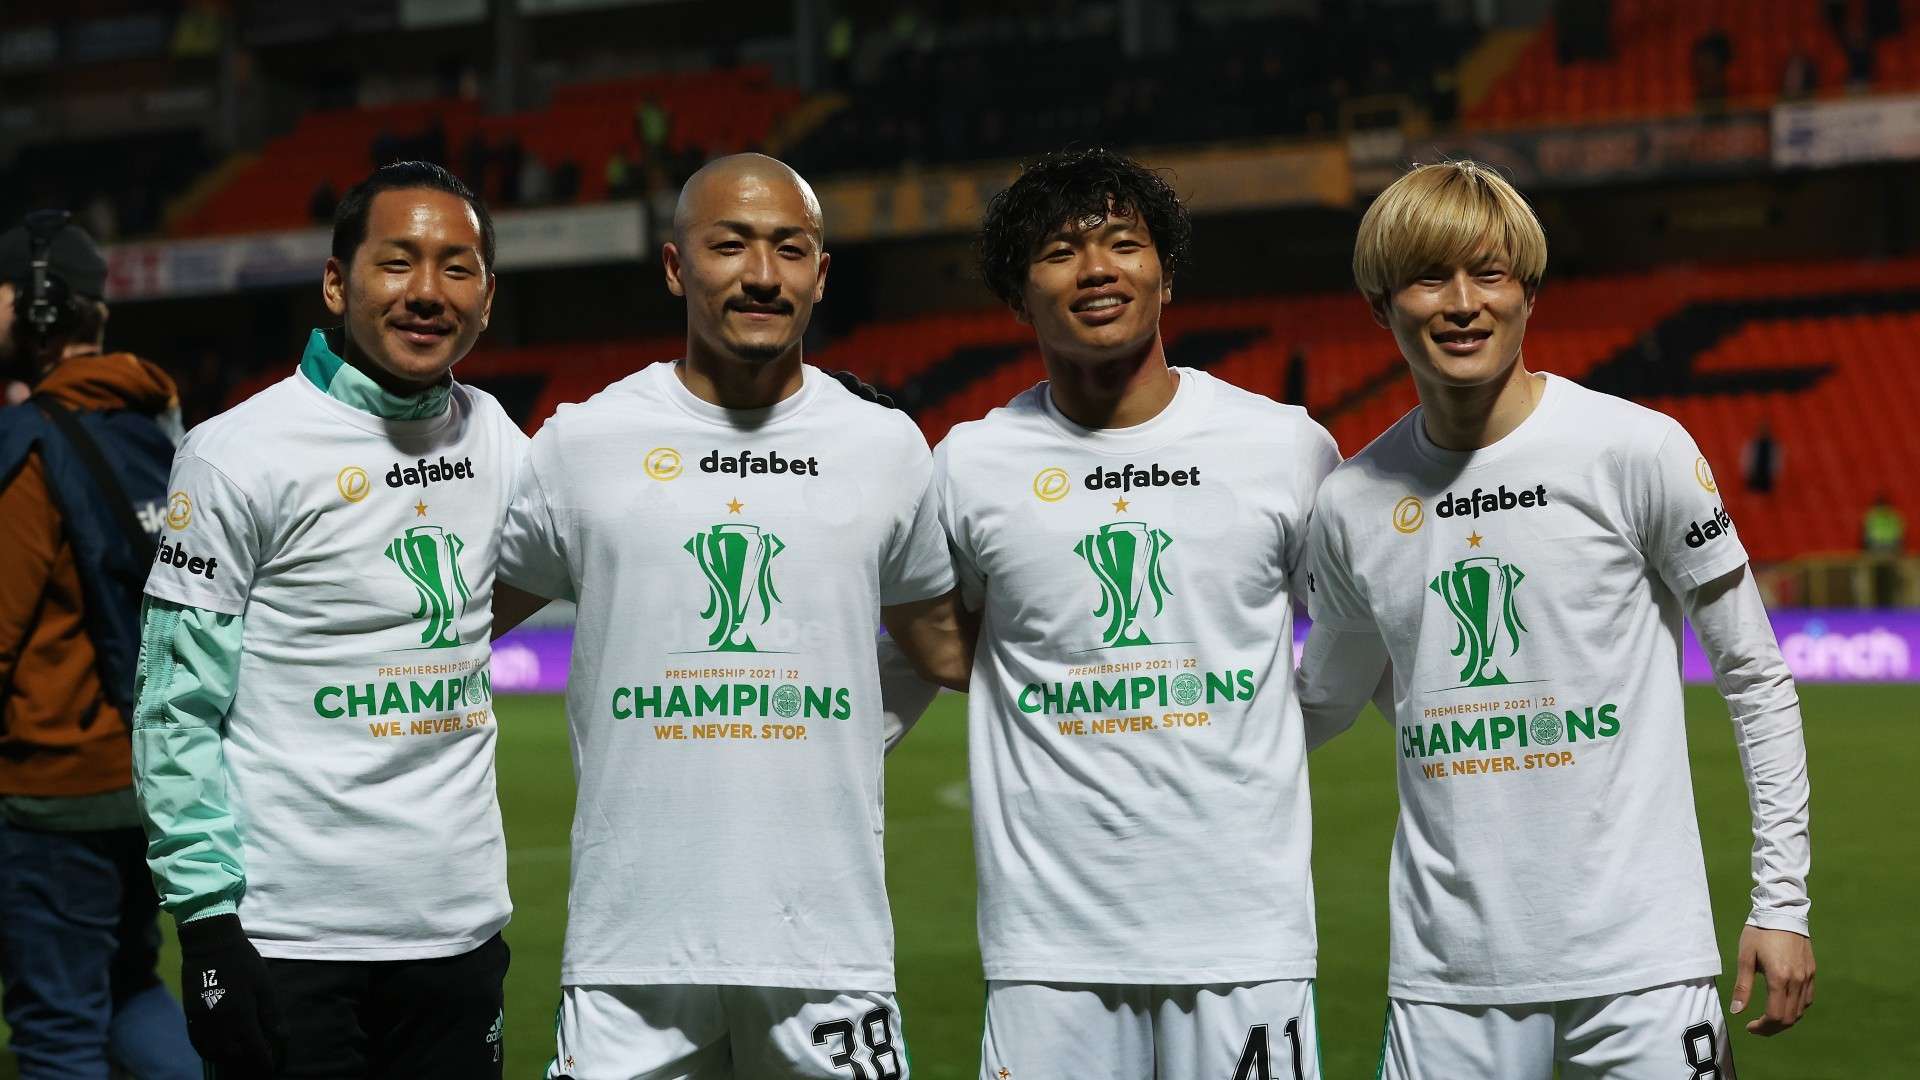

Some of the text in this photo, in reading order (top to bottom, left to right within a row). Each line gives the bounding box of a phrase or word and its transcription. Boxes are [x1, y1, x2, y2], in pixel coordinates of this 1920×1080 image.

[385, 456, 474, 489] dafabet
[700, 450, 819, 478] dafabet
[1084, 463, 1200, 492] dafabet
[1435, 484, 1548, 519] dafabet
[378, 663, 457, 677] PREMIERSHIP
[665, 669, 799, 679] PREMIERSHIP 2021 22
[1068, 658, 1197, 676] PREMIERSHIP 2021 22
[612, 683, 851, 721] CHAMPIONS
[1017, 668, 1255, 715] CHAMPIONS
[1424, 697, 1556, 718] PREMIERSHIP 2021 22
[369, 721, 405, 737] WE.
[410, 717, 463, 736] NEVER.
[654, 723, 807, 741] WE. NEVER. STOP.
[1057, 711, 1211, 736] WE. NEVER. STOP.
[1401, 703, 1621, 759] CHAMPIONS
[1422, 751, 1575, 780] WE. NEVER. STOP.
[811, 1006, 900, 1080] 38
[1230, 1016, 1305, 1080] 41
[1681, 1019, 1721, 1080] 8
